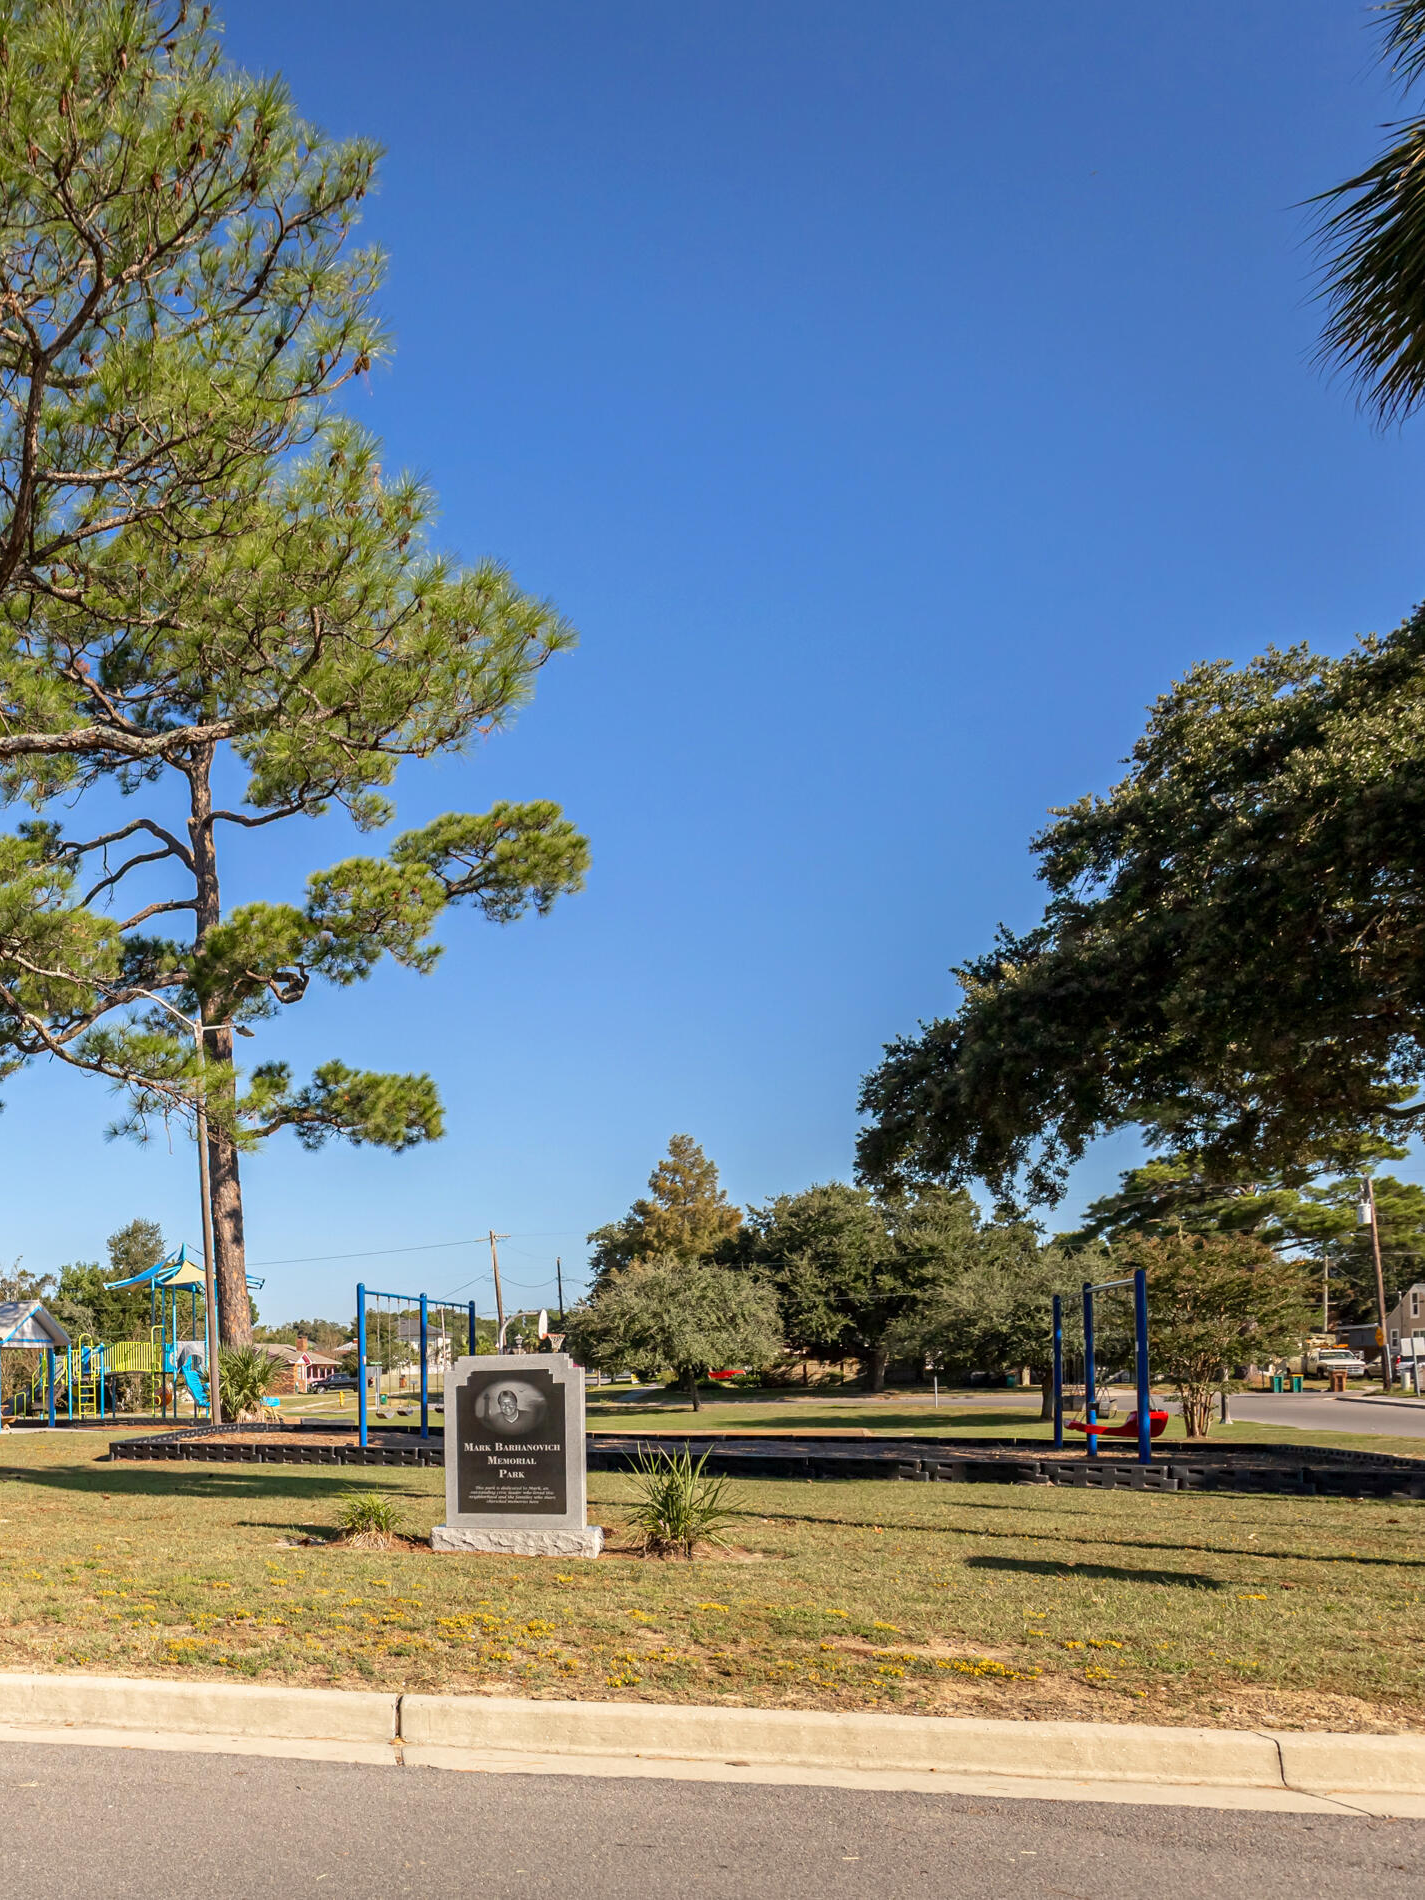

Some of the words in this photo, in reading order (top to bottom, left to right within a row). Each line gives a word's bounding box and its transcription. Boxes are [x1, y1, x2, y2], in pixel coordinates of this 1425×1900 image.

[463, 1442, 492, 1452] MARK
[487, 1455, 537, 1465] MEMORIAL
[499, 1469, 525, 1478] PARK
